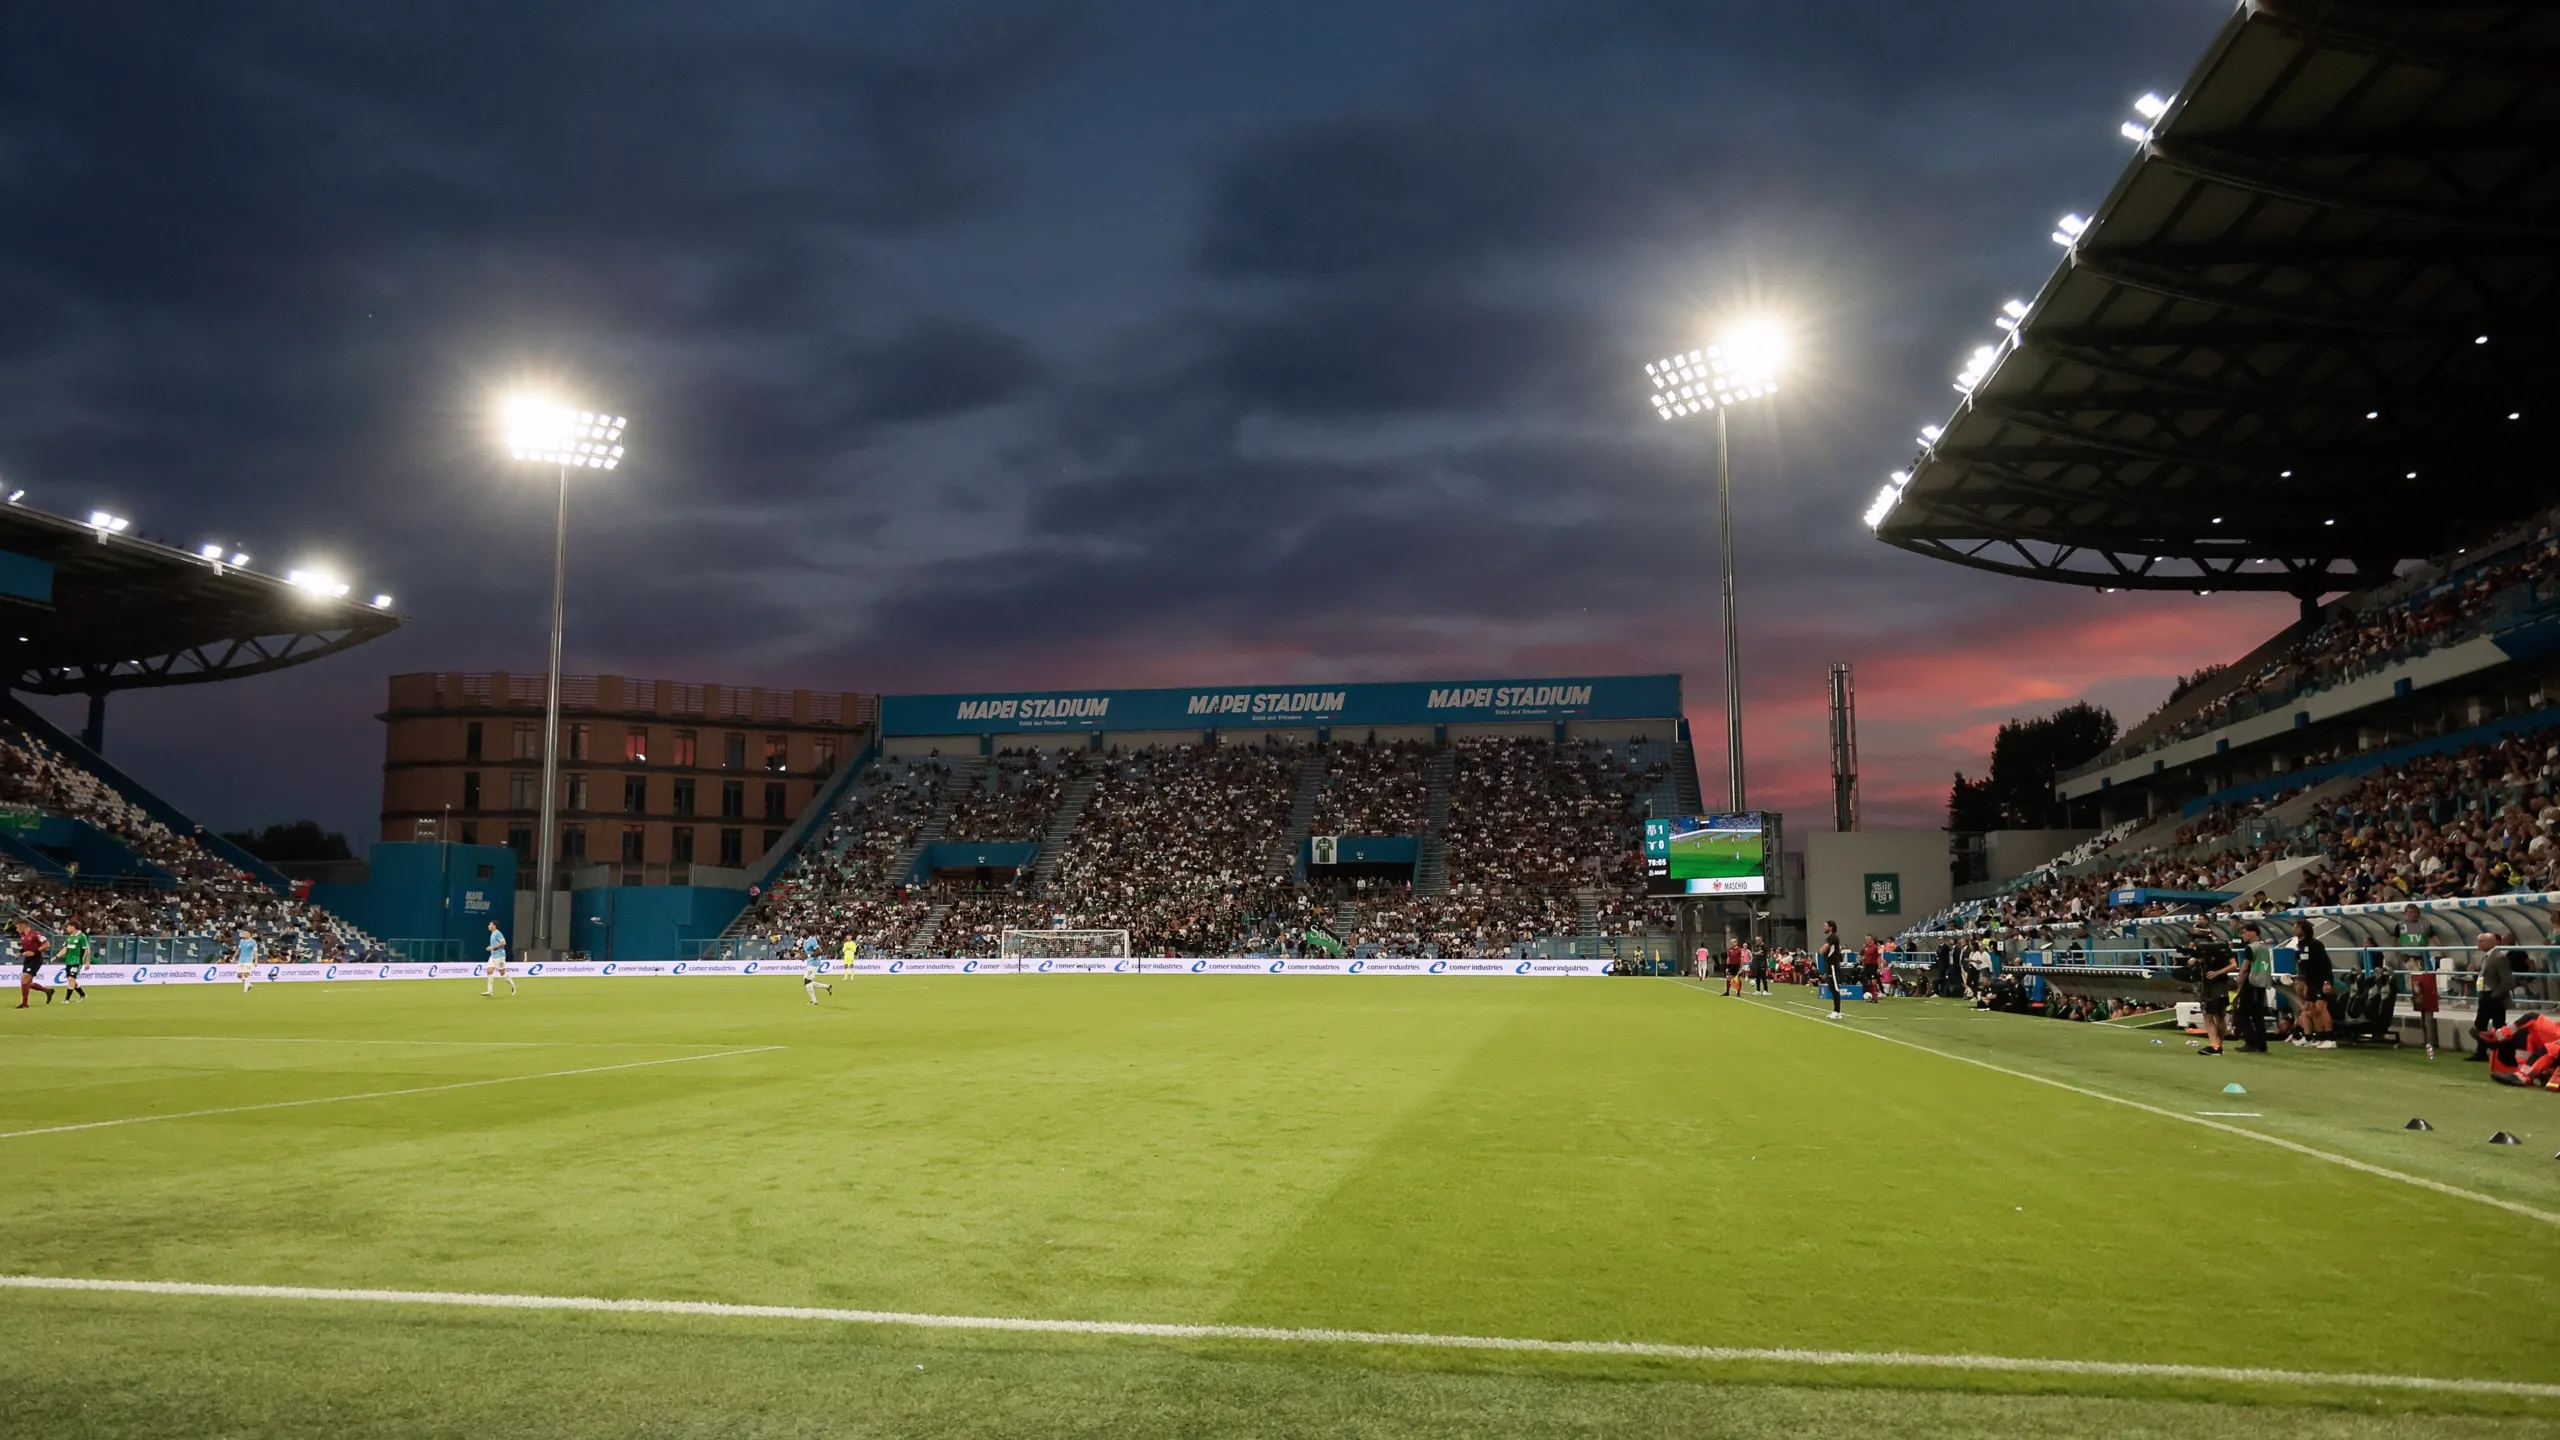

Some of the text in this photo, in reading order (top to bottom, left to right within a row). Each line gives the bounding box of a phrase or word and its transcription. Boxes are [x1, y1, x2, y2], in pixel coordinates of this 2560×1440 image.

[1427, 685, 1592, 708] MAPEI STADIUM
[1187, 692, 1345, 714] MAPEI STADIUM
[957, 697, 1110, 719] MAPEI STADIUM
[1658, 824, 1663, 834] 1
[1658, 840, 1664, 849] 0
[2408, 934, 2422, 942] TV
[94, 971, 125, 979] industries
[169, 970, 197, 978] industries
